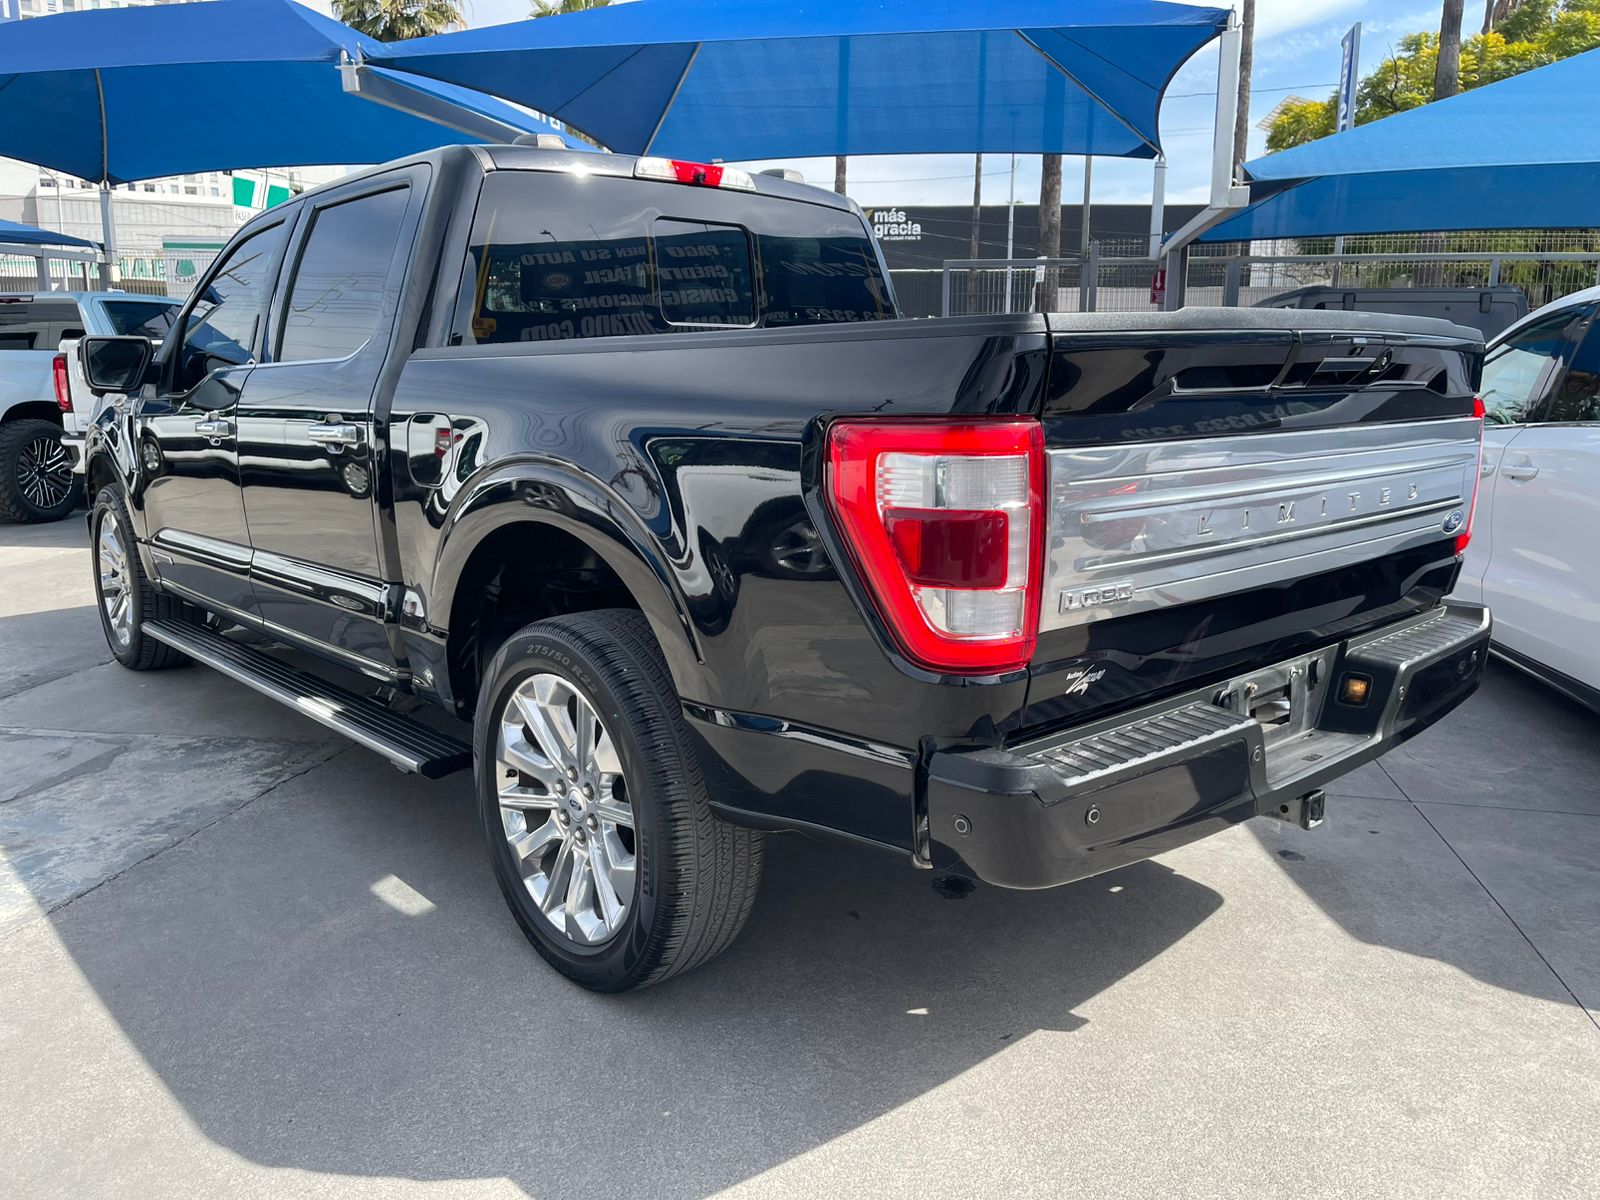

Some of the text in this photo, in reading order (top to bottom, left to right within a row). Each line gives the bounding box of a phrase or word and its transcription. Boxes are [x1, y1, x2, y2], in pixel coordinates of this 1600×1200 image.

[874, 207, 906, 222] más
[874, 220, 921, 238] gracia
[1197, 482, 1419, 536] LIMITED
[525, 643, 599, 696] 275/50 R22
